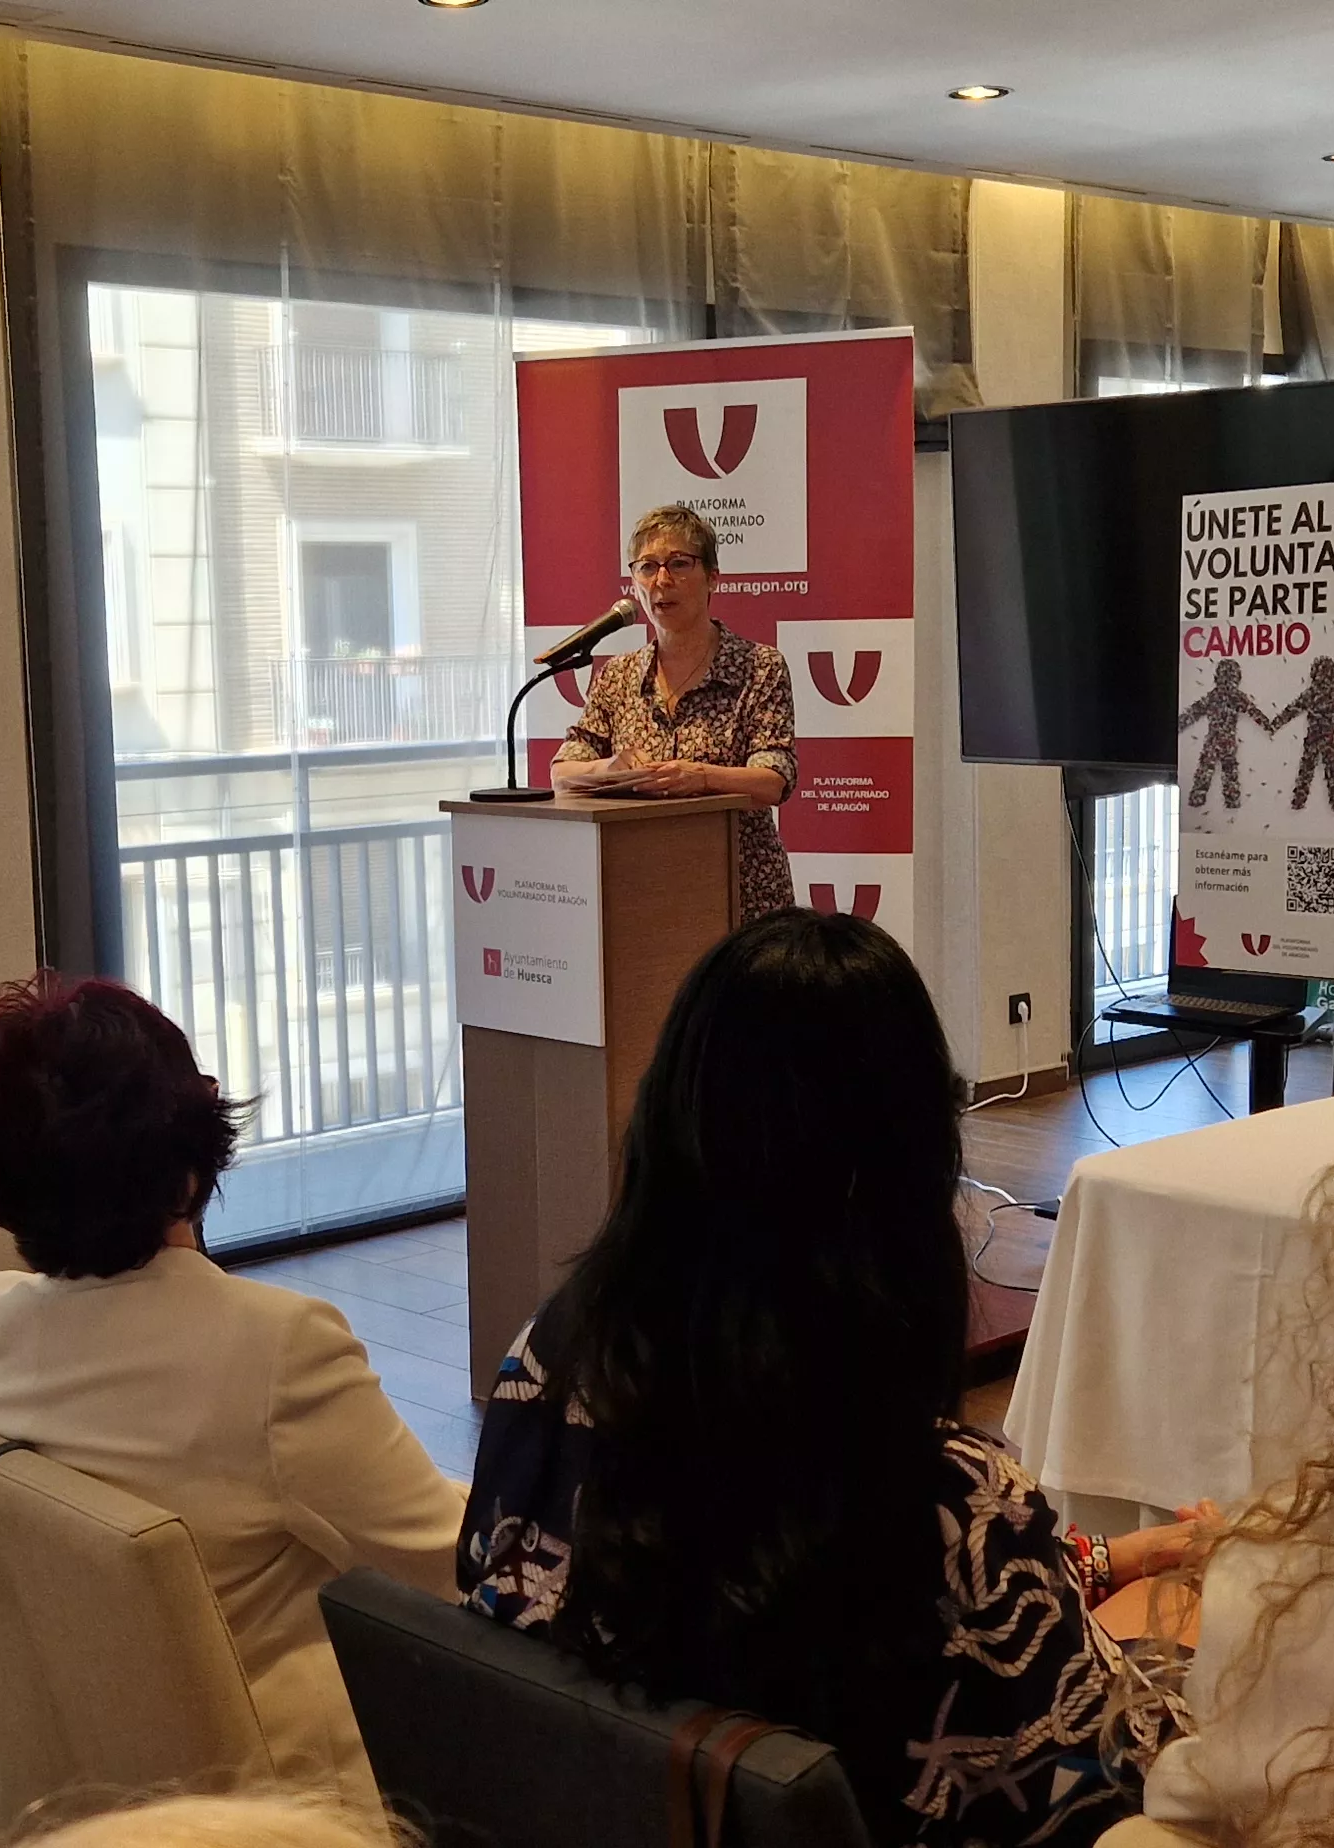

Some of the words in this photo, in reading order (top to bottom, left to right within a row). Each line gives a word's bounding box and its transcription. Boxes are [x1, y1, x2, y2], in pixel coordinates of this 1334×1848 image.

[1187, 500, 1282, 542] ÚNETE
[1291, 500, 1332, 534] AL
[1185, 588, 1218, 619] SE
[1229, 581, 1327, 617] PARTE
[1183, 622, 1311, 658] CAMBIO
[831, 802, 869, 811] ARAGÓN
[1195, 850, 1245, 862] Escanéame
[1247, 853, 1268, 862] para
[1195, 866, 1231, 875] obtener
[1233, 867, 1251, 877] más
[515, 880, 555, 891] PLATAFORMA
[1195, 880, 1249, 892] información
[497, 889, 546, 901] VOLUNTARIADO
[548, 895, 555, 903] DE
[558, 896, 587, 906] ARAGÓN
[504, 952, 567, 970] Ayuntamiento
[504, 968, 514, 978] de
[518, 968, 552, 984] Huesca
